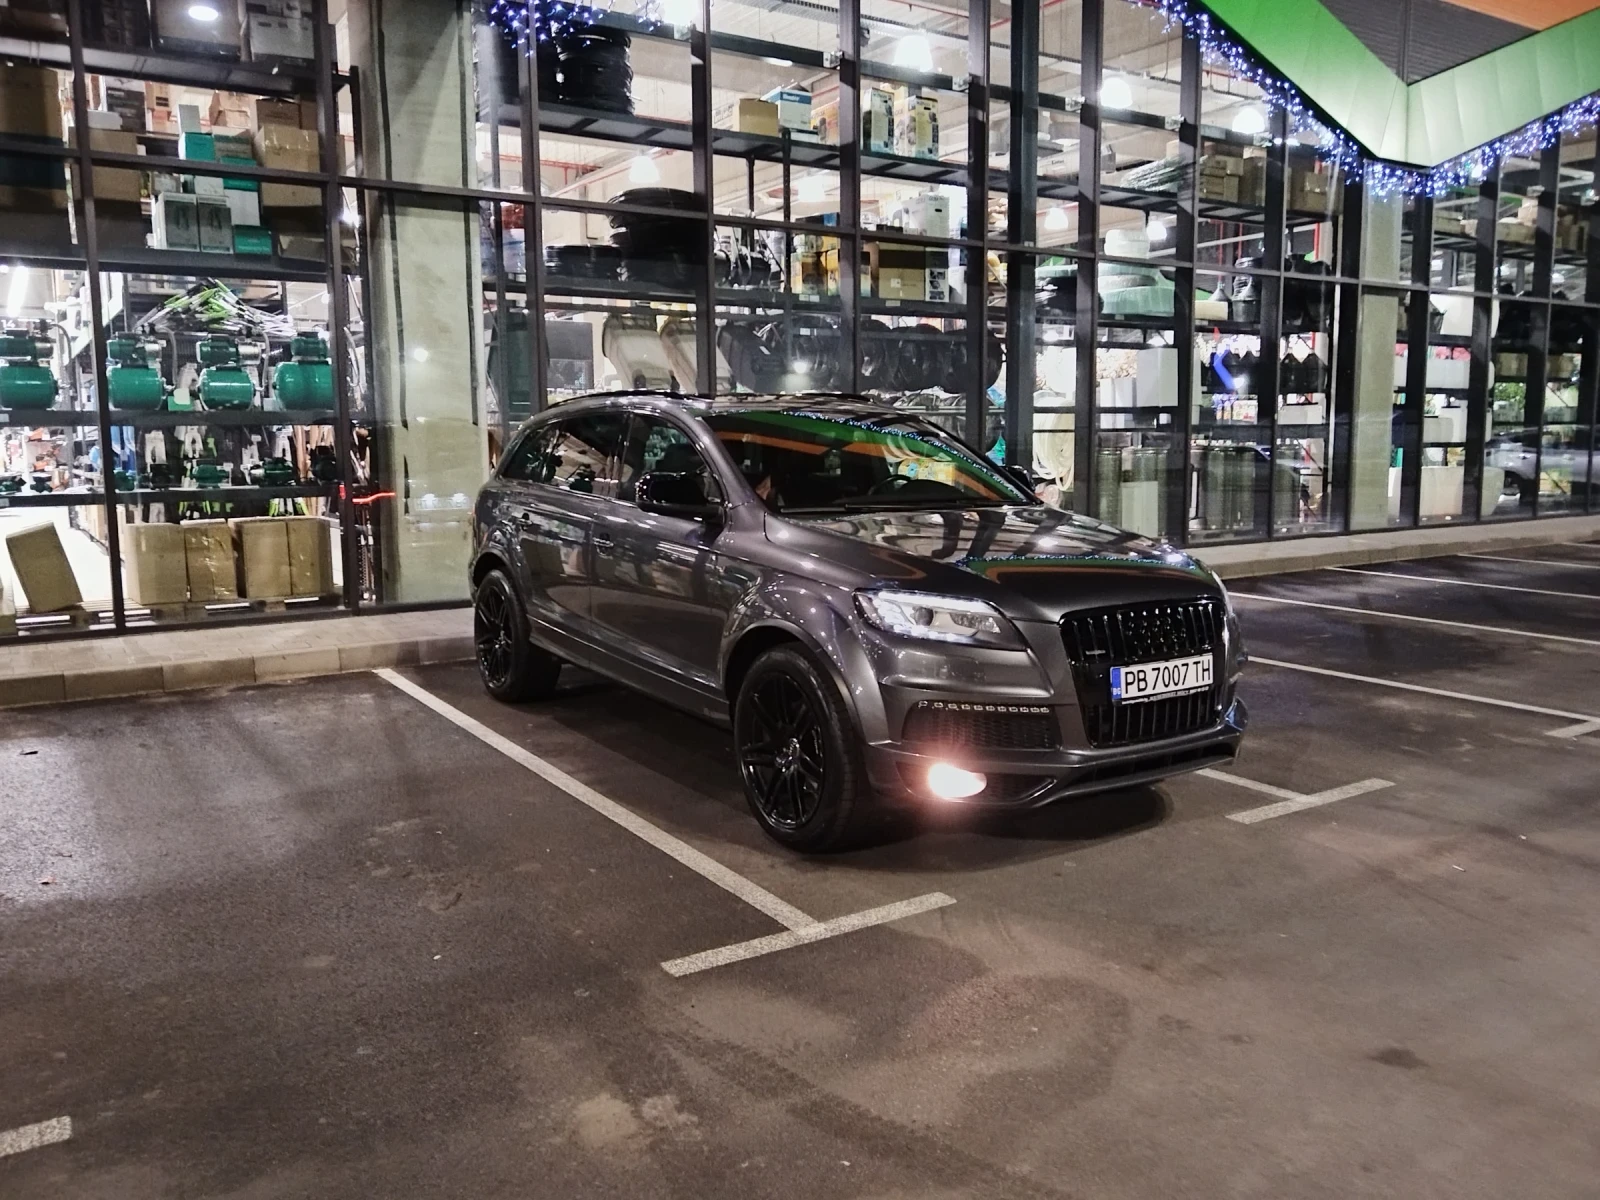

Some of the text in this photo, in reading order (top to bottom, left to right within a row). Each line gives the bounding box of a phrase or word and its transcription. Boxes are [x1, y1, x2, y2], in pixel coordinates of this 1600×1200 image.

[1125, 659, 1211, 694] PB 7007 TH
